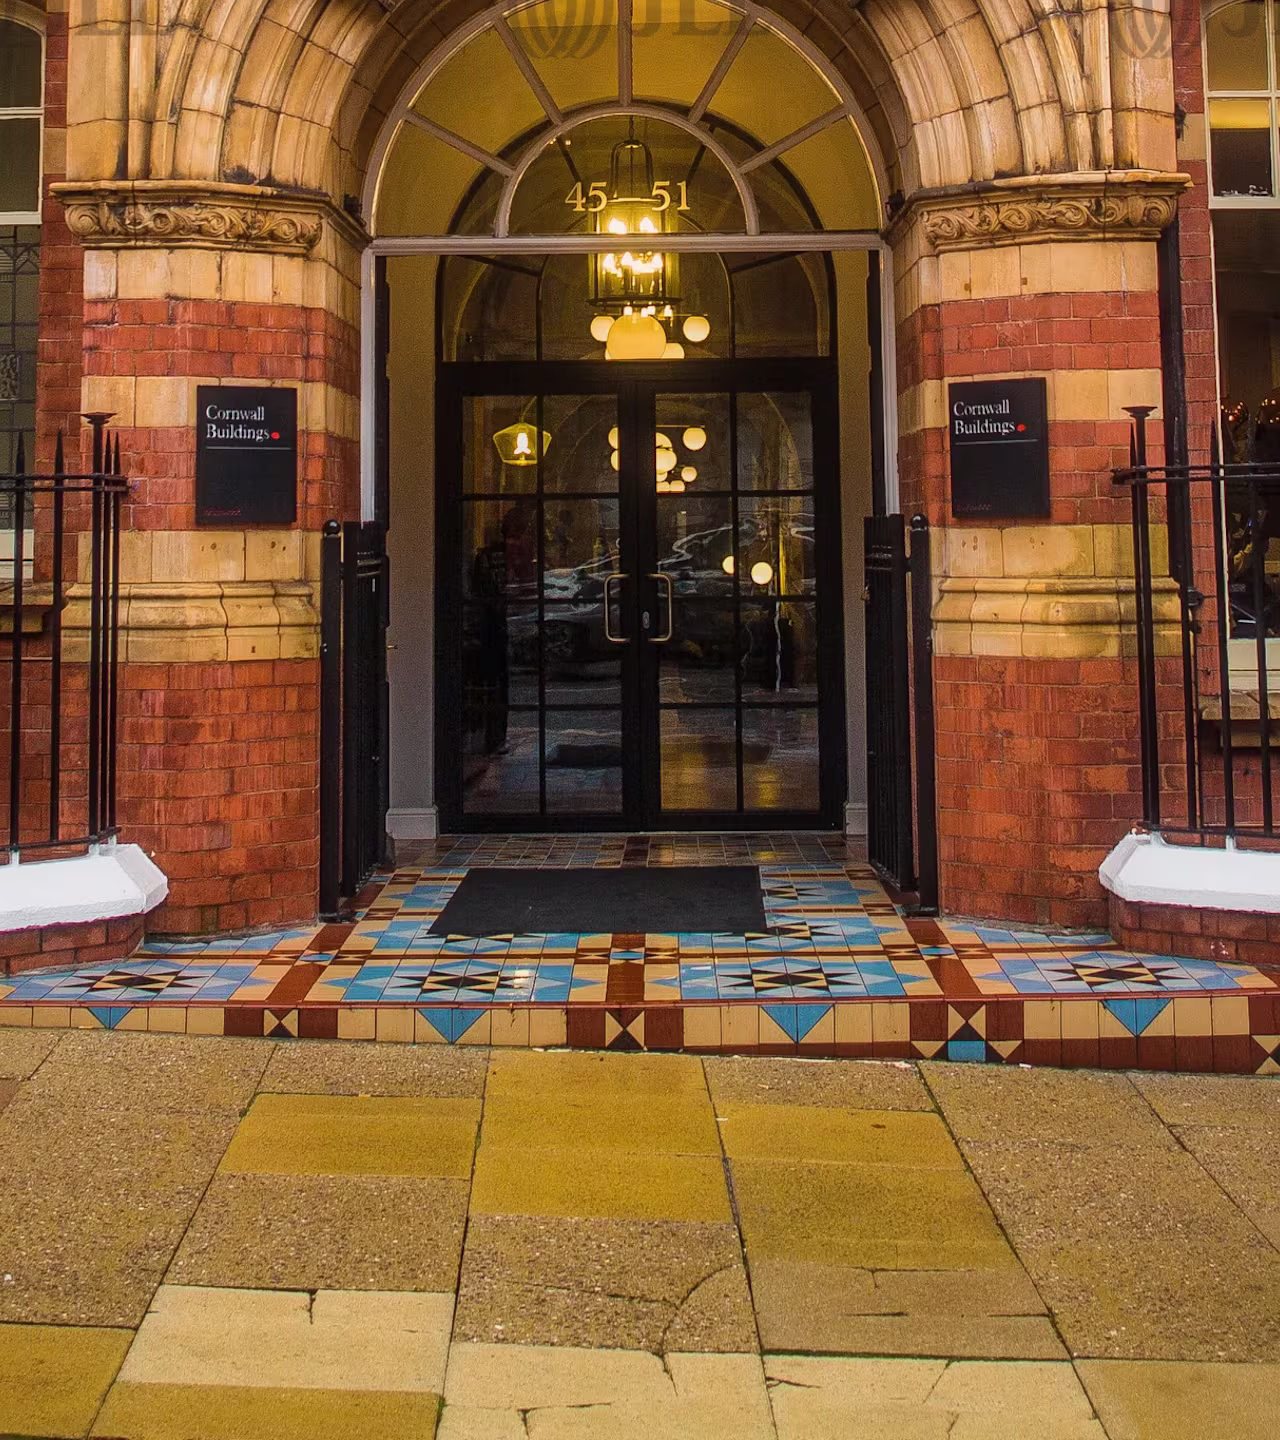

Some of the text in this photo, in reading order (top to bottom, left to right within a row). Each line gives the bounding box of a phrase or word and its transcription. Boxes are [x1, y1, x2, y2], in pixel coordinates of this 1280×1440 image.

[565, 180, 691, 212] 45 51
[206, 404, 265, 421] Cornwall
[953, 399, 1010, 416] Cornwall
[206, 424, 270, 442] Buildings
[954, 419, 1016, 436] Buildings
